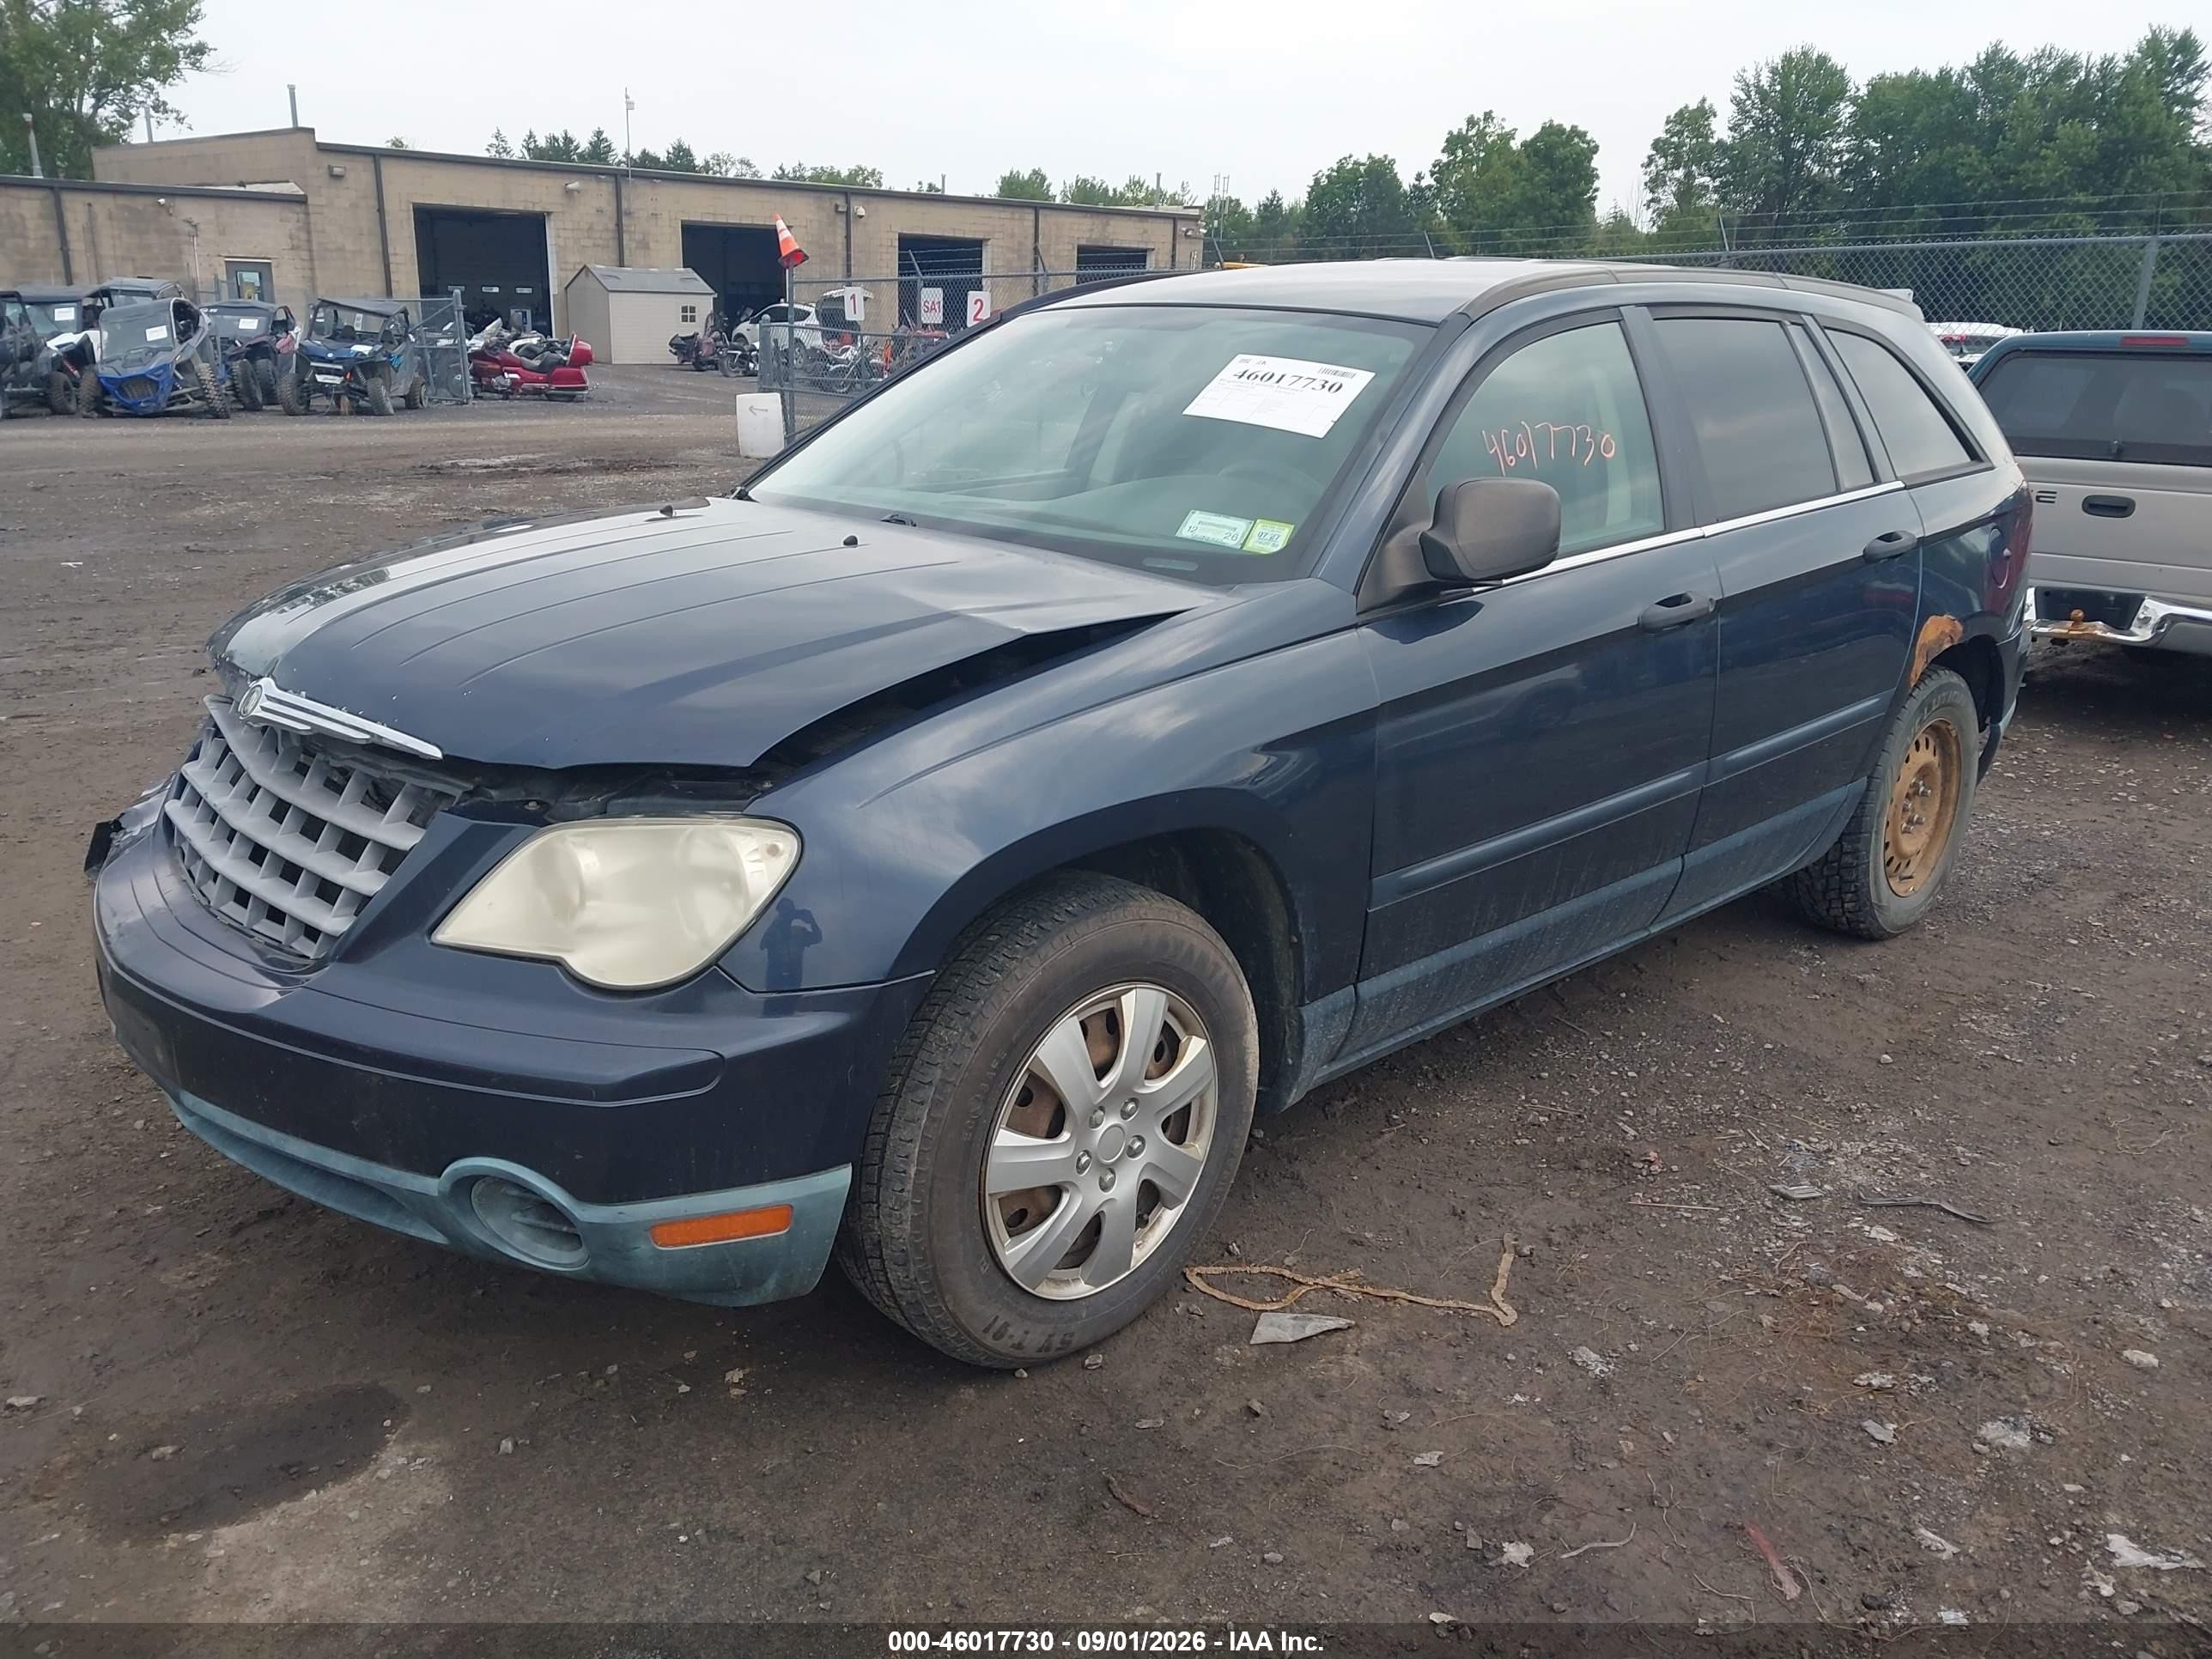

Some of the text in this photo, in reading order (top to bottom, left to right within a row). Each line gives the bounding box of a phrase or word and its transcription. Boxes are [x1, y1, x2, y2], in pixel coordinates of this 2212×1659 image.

[849, 293, 856, 315] 1
[923, 301, 941, 313] SA1
[972, 298, 983, 321] 2
[1233, 369, 1344, 394] 46017730
[1481, 421, 1615, 477] 46017730
